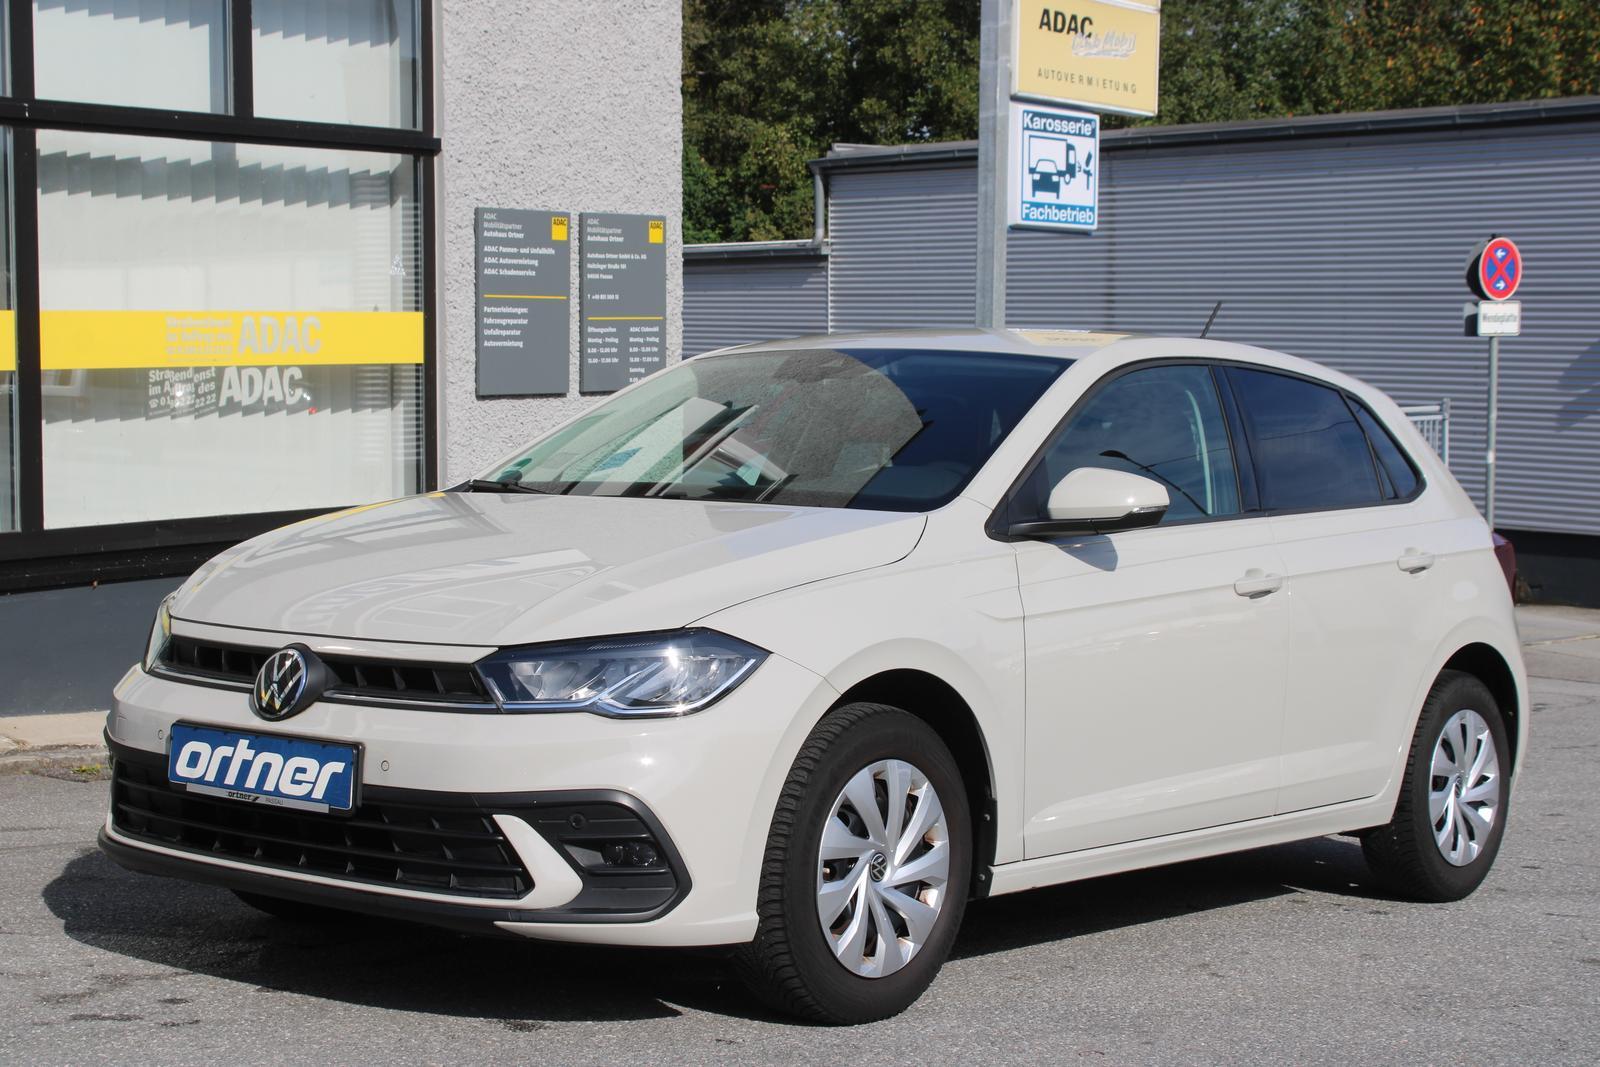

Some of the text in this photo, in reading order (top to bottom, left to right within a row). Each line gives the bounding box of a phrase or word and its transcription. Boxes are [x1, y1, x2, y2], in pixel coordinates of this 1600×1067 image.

[1039, 8, 1094, 38] ADAC
[1037, 67, 1137, 94] AUTOVERMIETUNG
[1023, 112, 1093, 136] Karosserie
[484, 212, 497, 220] ADAC
[1022, 203, 1095, 223] Fachbetrieb
[552, 218, 567, 226] ADAC
[650, 222, 663, 230] ADAC
[484, 230, 525, 239] Autohaus Ortner
[484, 245, 498, 253] ADAC
[499, 257, 539, 267] Autovermietung
[239, 315, 321, 354] ADAC
[218, 366, 303, 407] ADAC
[175, 738, 346, 800] ortner
[228, 791, 251, 800] ortner
